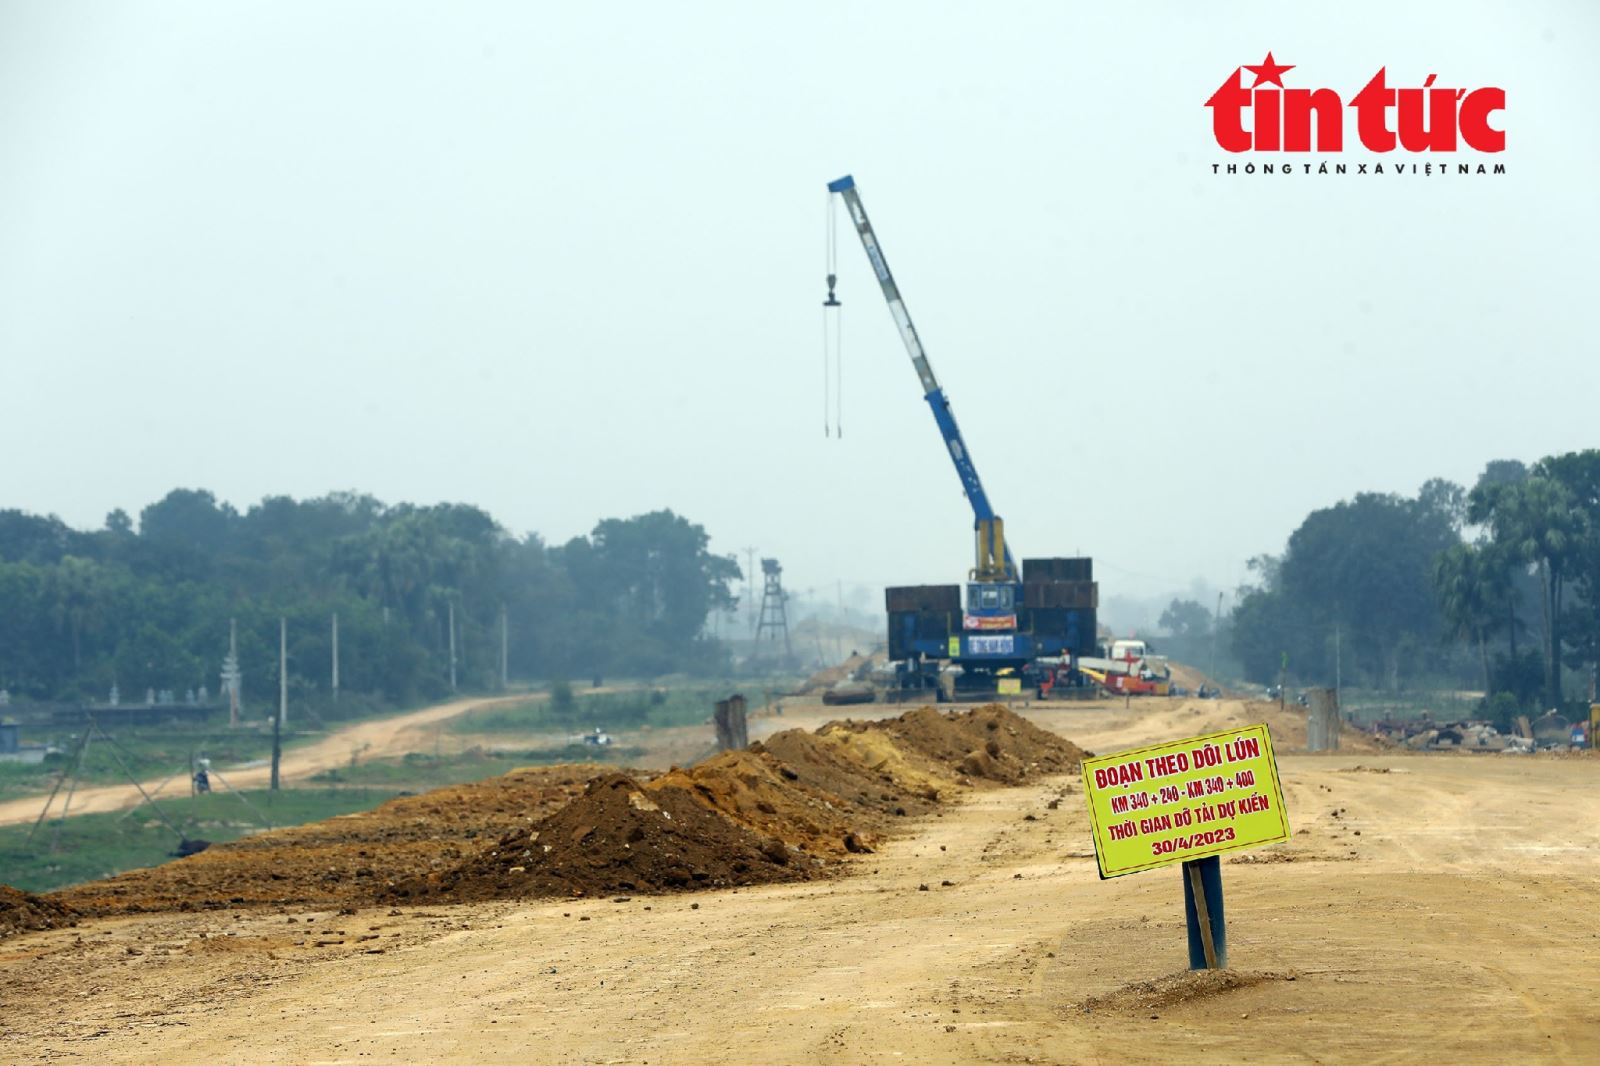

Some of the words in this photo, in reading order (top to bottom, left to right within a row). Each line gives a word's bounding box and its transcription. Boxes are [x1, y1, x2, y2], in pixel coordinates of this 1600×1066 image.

[1095, 762, 1143, 789] ĐOẠN
[1145, 753, 1189, 778] THEO
[1192, 744, 1222, 769] DÕI
[1225, 737, 1260, 762] LÚN
[1111, 796, 1129, 814] KM
[1130, 792, 1149, 810] 340
[1160, 786, 1179, 804] 240
[1186, 780, 1204, 799] KM
[1205, 777, 1224, 795] 340
[1236, 770, 1255, 788] 400
[1108, 819, 1138, 841] THỜI
[1140, 815, 1172, 834] GIAN
[1174, 808, 1192, 827] DỠ
[1194, 802, 1216, 824] TẢI
[1217, 800, 1236, 820] DỰ
[1238, 792, 1270, 814] KIẾN
[1152, 827, 1236, 855] 30/4/2023
